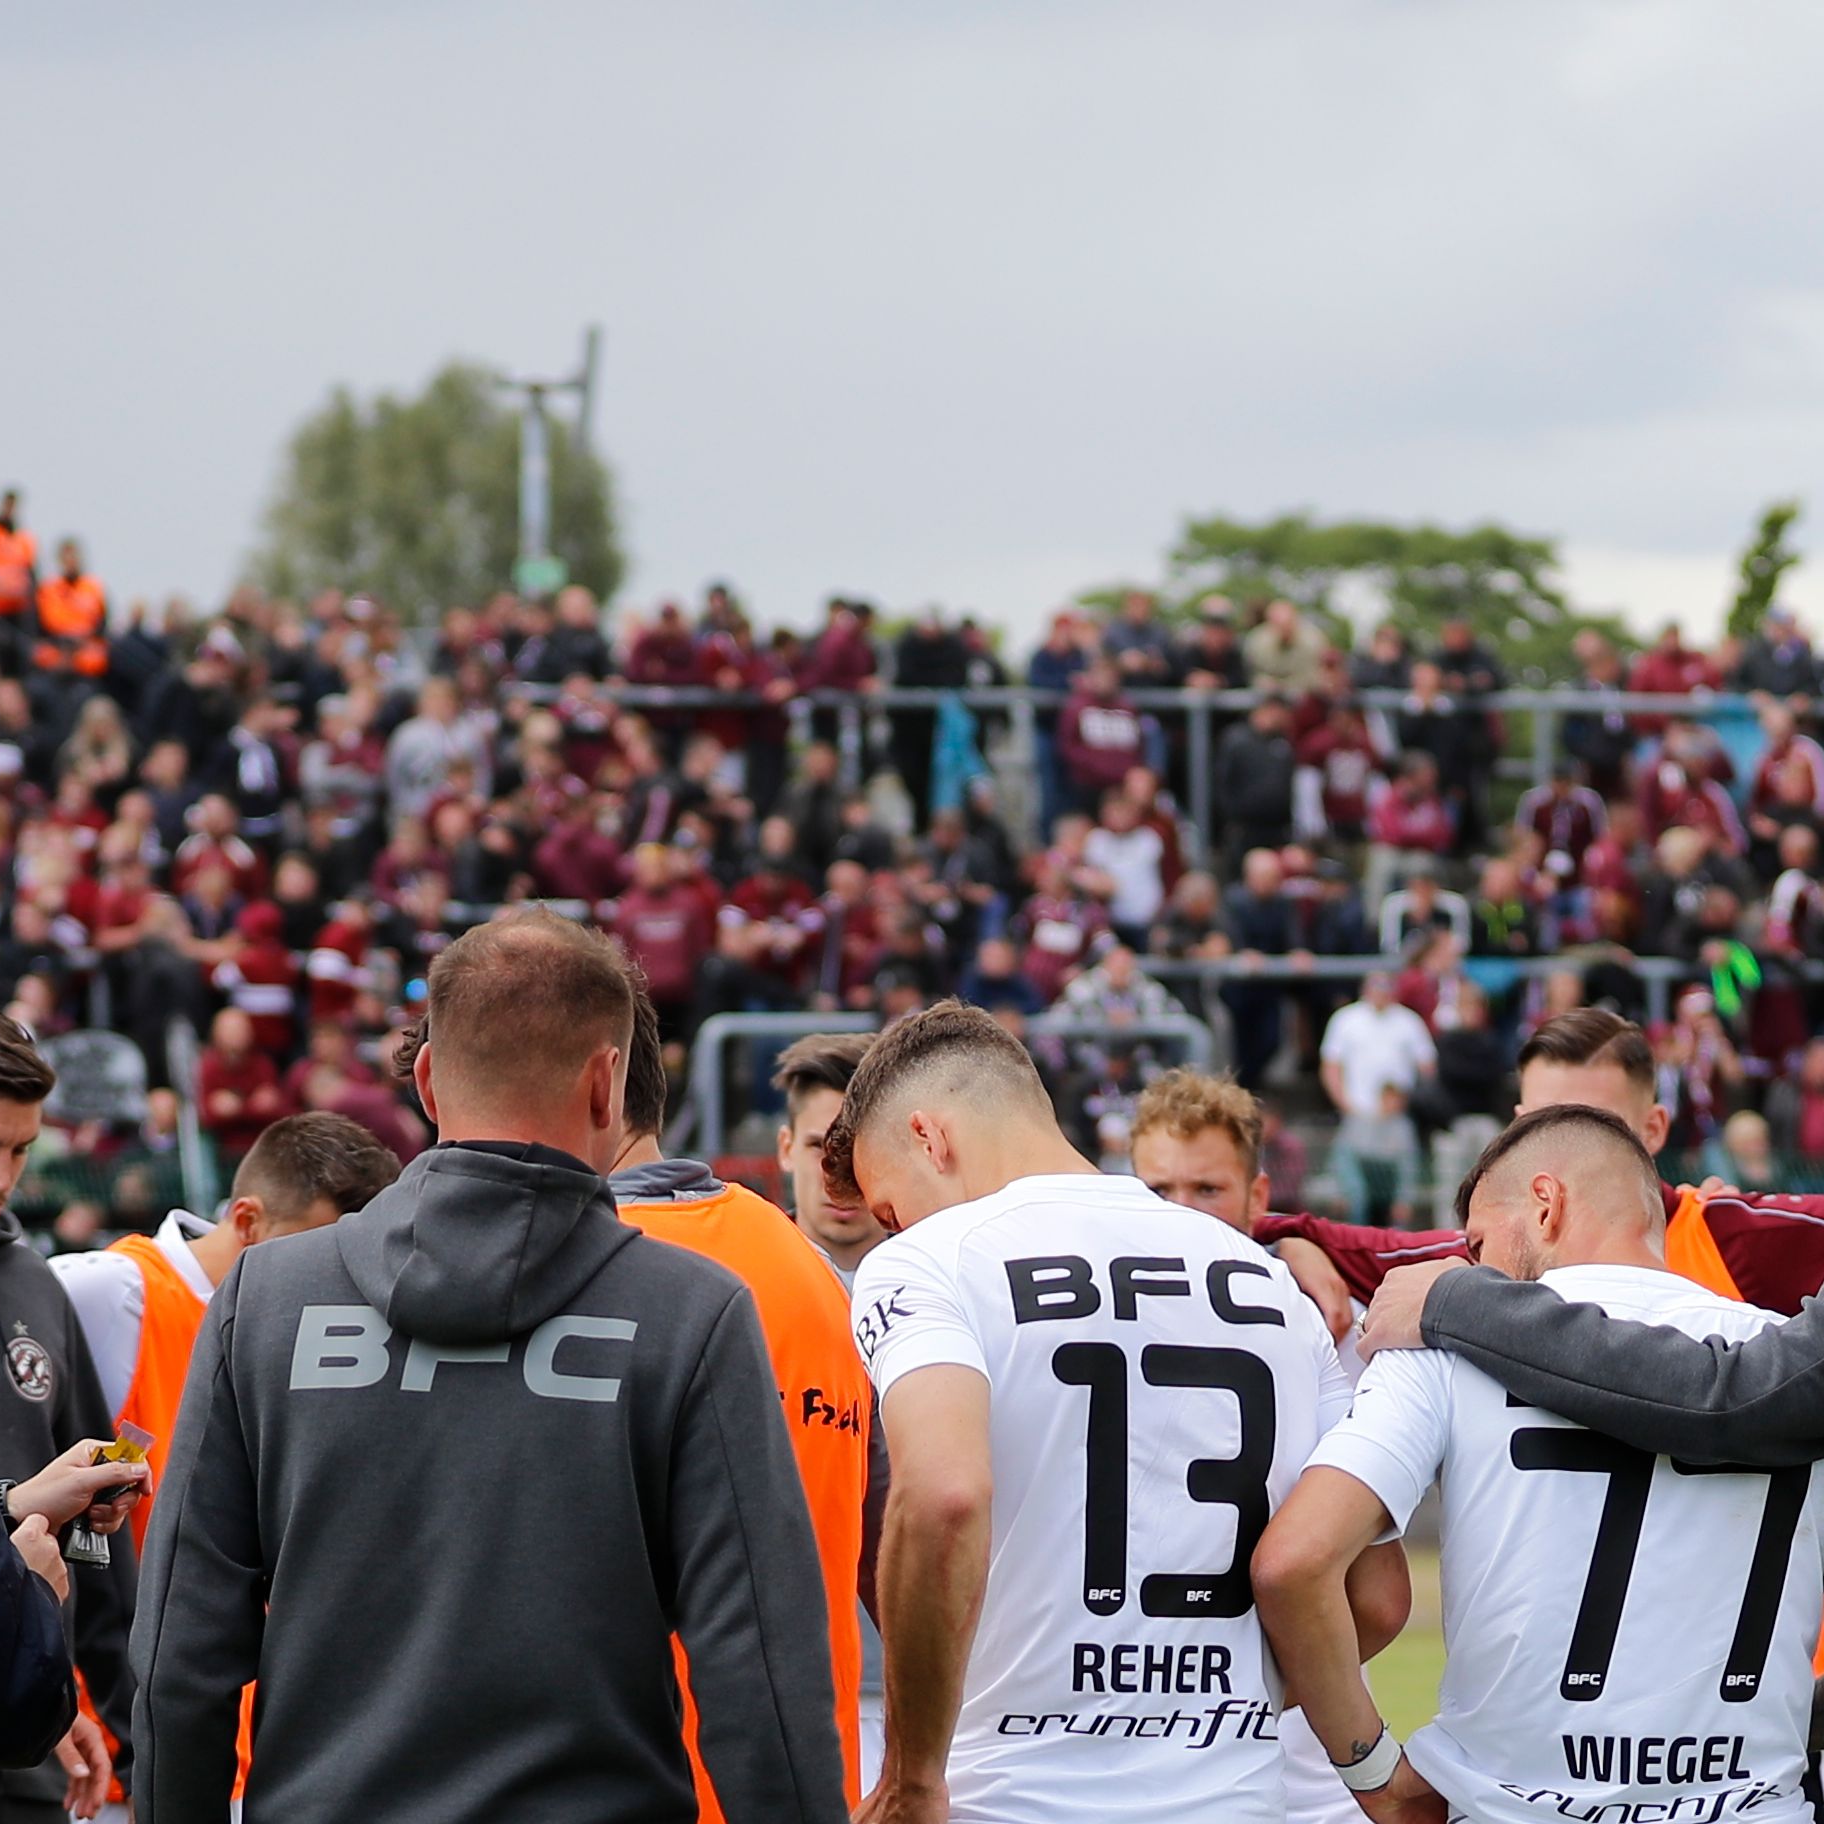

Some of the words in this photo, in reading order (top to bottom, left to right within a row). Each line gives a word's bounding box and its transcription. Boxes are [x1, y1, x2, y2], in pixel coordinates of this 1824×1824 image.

[1004, 1255, 1286, 1327] BFC
[289, 1305, 639, 1402] BFC
[1052, 1342, 1277, 1618] 13
[1510, 1427, 1812, 1702] 77
[1088, 1588, 1122, 1600] BFC
[1186, 1590, 1212, 1602] BFC
[1073, 1643, 1232, 1694] REHER
[1567, 1673, 1601, 1685] BFC
[1726, 1675, 1756, 1686] BFC
[997, 1700, 1279, 1749] crunchfit
[1562, 1734, 1751, 1786] WIEGEL
